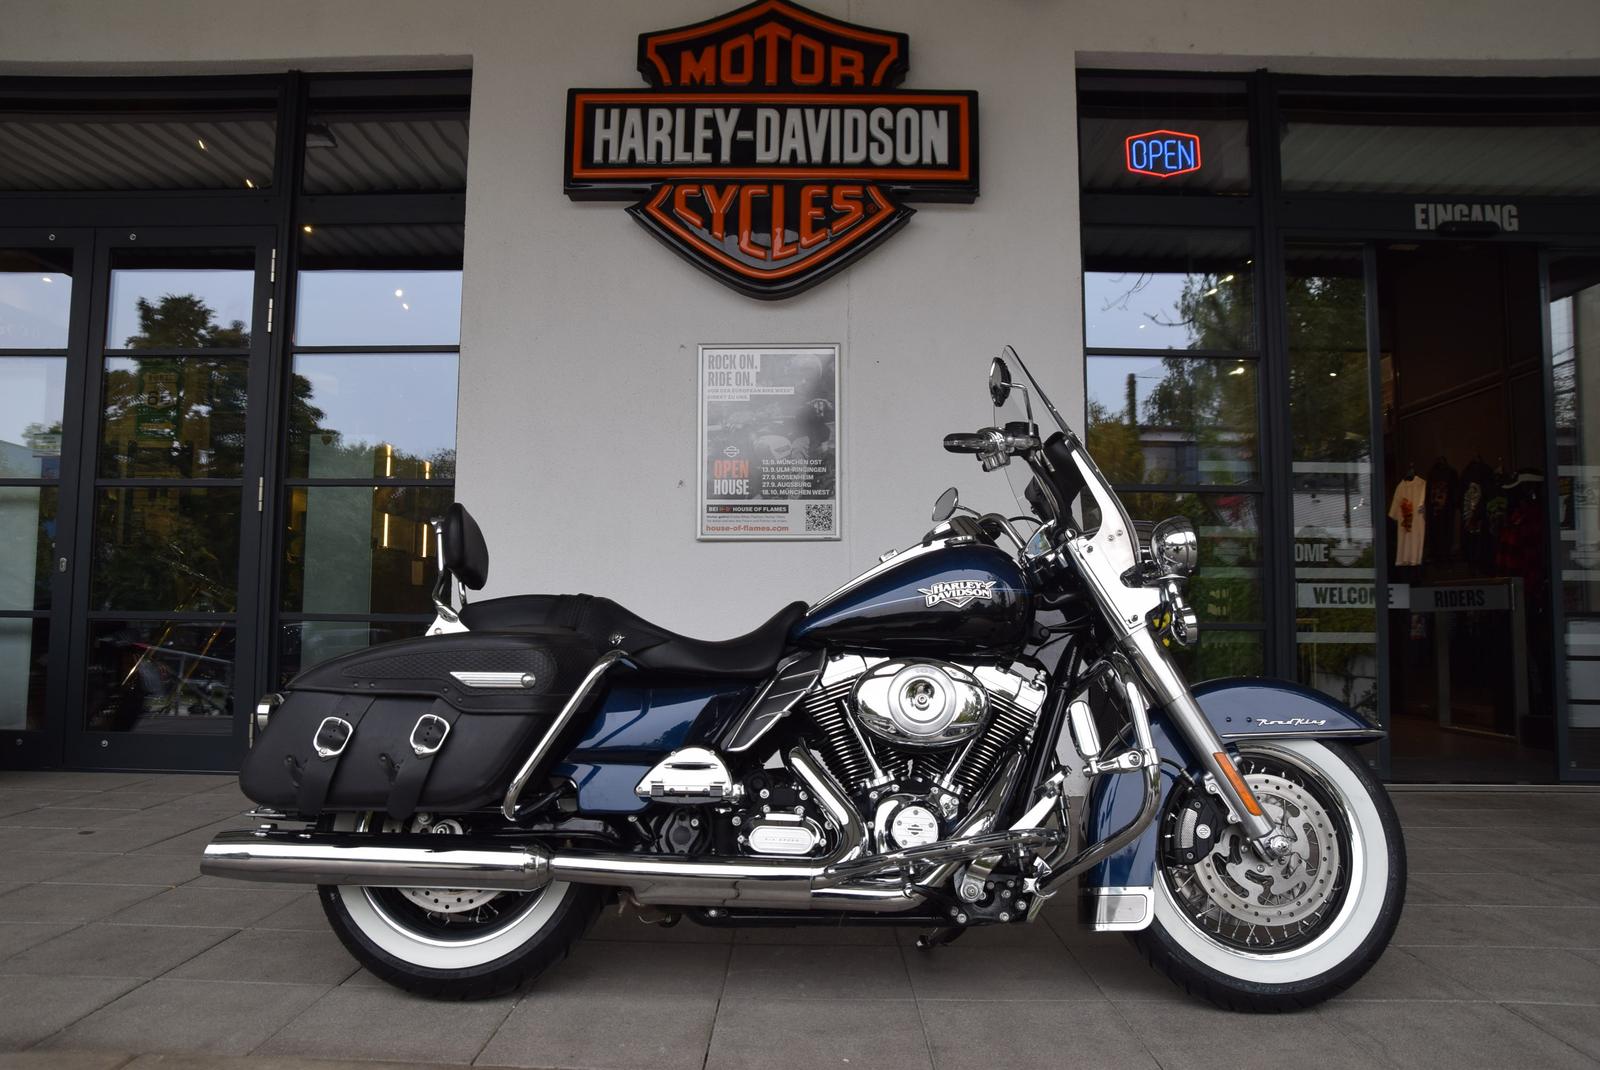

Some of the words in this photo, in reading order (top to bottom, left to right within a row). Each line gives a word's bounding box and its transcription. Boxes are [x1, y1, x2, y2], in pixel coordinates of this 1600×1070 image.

[680, 21, 865, 86] MOTOR
[593, 107, 949, 166] HARLEY-DAVIDSON
[1132, 139, 1194, 170] OPEN
[673, 184, 865, 261] CYCLES
[1414, 203, 1519, 232] EINGANG
[708, 354, 737, 370] ROCK
[740, 354, 758, 370] ON.
[708, 371, 733, 387] RIDE
[735, 371, 754, 387] ON.
[714, 459, 750, 479] OPEN
[713, 479, 750, 495] HOUSE
[928, 589, 990, 605] DAVIDSON
[1433, 589, 1485, 608] RIDERS
